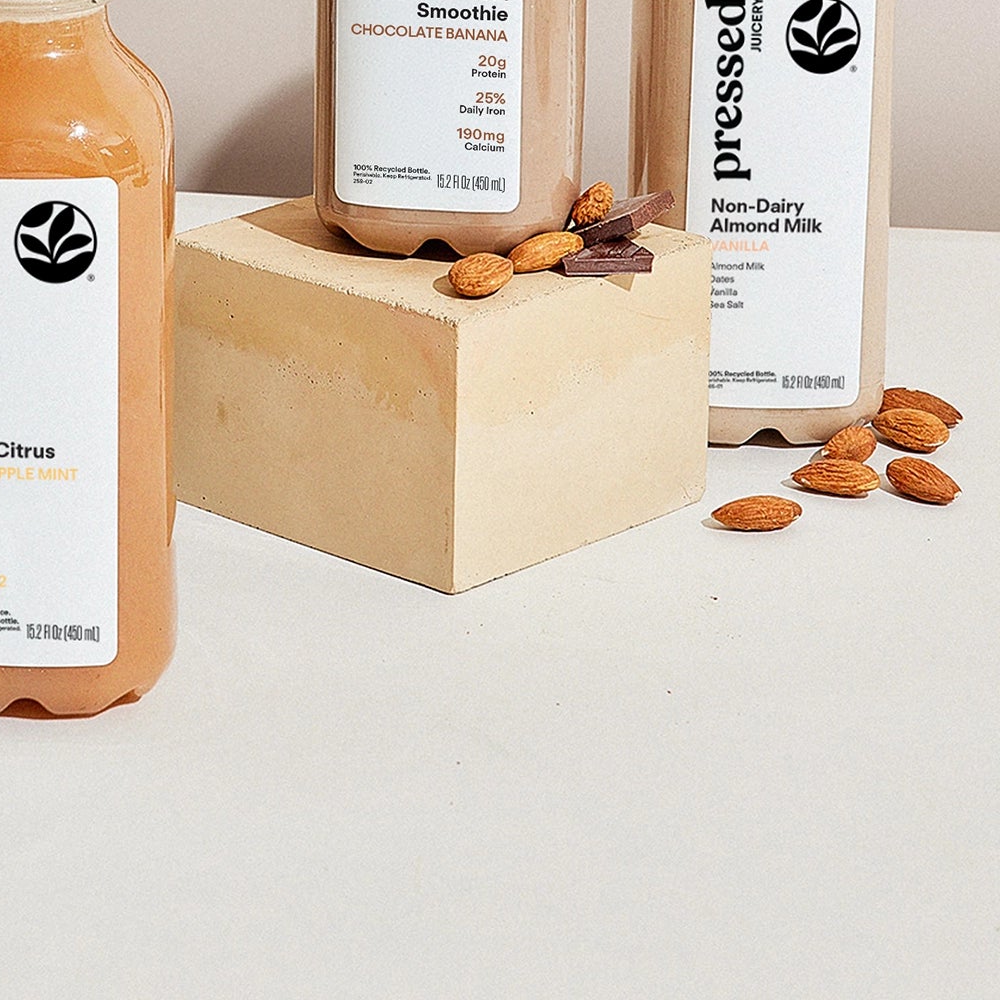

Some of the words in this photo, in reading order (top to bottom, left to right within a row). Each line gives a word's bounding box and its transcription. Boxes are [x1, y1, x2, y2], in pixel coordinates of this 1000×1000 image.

[417, 2, 508, 21] Smoothie
[351, 23, 442, 39] CHOCOLATE
[446, 28, 508, 42] BANANA
[478, 55, 506, 70] 20g
[472, 69, 506, 78] Protein
[476, 92, 506, 104] 25%
[459, 105, 484, 116] Daily
[486, 106, 505, 115] Iron
[457, 128, 504, 143] 190mg
[465, 142, 504, 152] Calcium
[374, 165, 406, 173] Recycled
[437, 175, 451, 188] 15.2
[453, 175, 459, 189] Fl
[461, 176, 470, 190] Oz
[473, 176, 489, 191] (450
[491, 177, 505, 193] mL)
[711, 198, 804, 216] Non-Dairy
[710, 218, 779, 233] Almond
[784, 218, 822, 233] Milk
[711, 241, 769, 251] VANILLA
[710, 301, 724, 309] Sea
[727, 301, 744, 309] Salt
[38, 468, 78, 481] MINT
[26, 624, 41, 640] 15.2
[52, 625, 62, 640] Oz
[64, 625, 82, 641] (450
[84, 626, 99, 642] mL)
